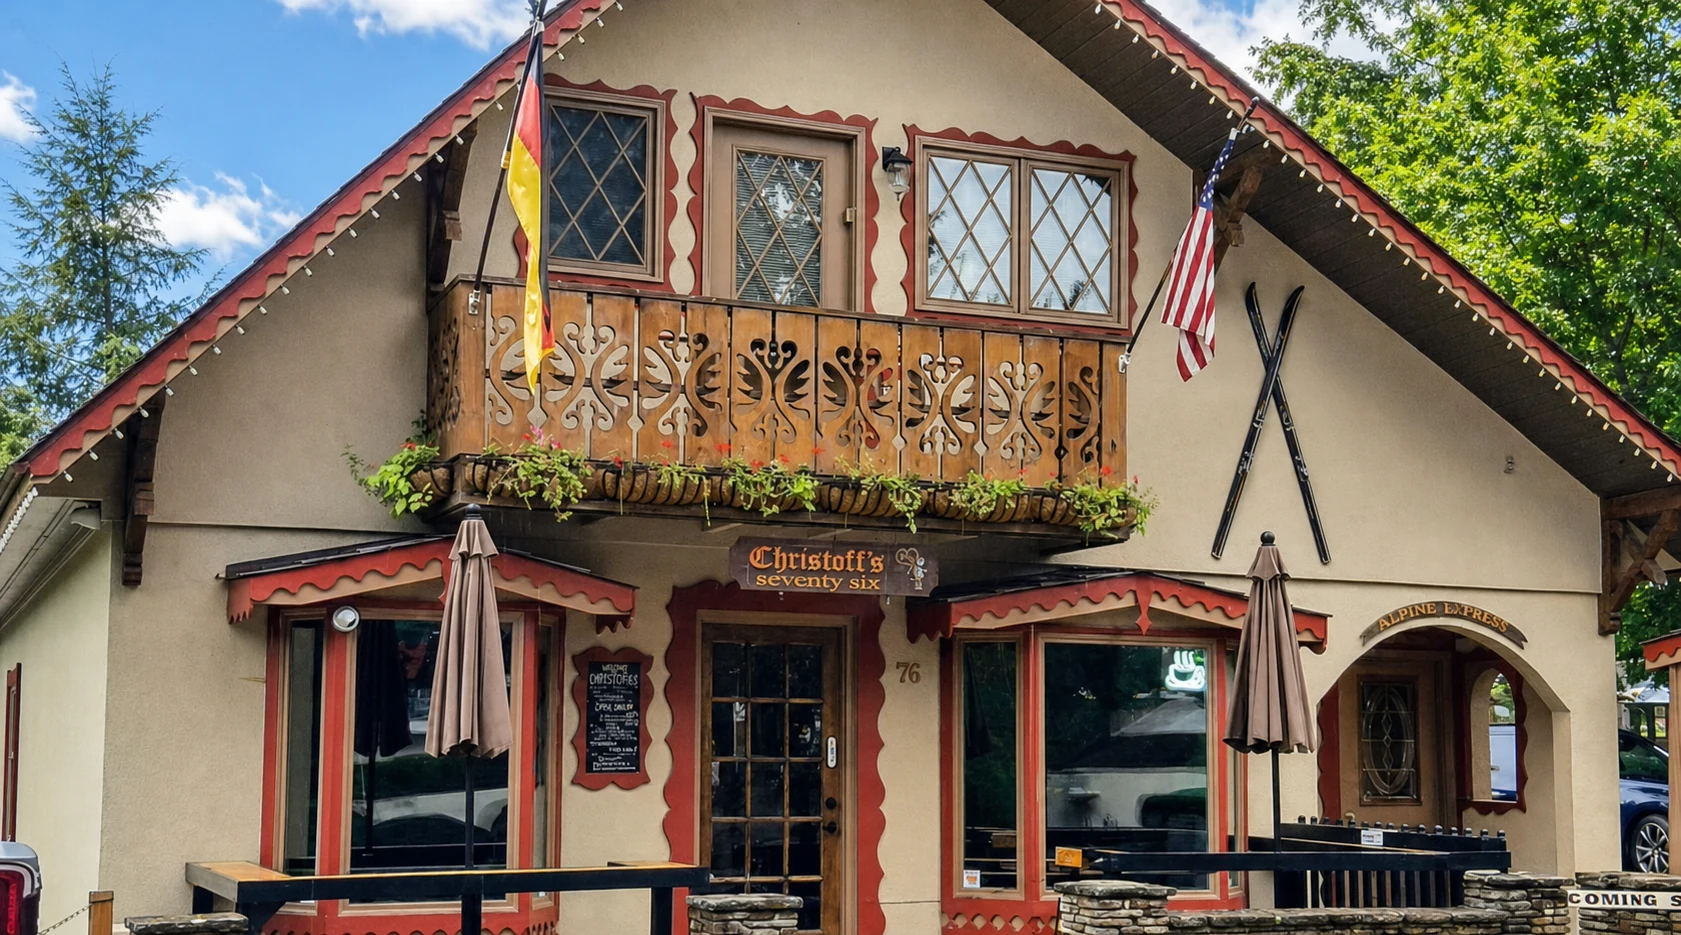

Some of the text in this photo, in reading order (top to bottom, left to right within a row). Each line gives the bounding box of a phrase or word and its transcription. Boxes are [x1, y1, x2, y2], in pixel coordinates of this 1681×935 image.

[750, 545, 885, 574] Christoff's
[756, 574, 881, 592] seventy six
[1378, 602, 1509, 633] ALPINE EXPRESS
[896, 661, 921, 684] 76
[1568, 893, 1658, 907] COMING
